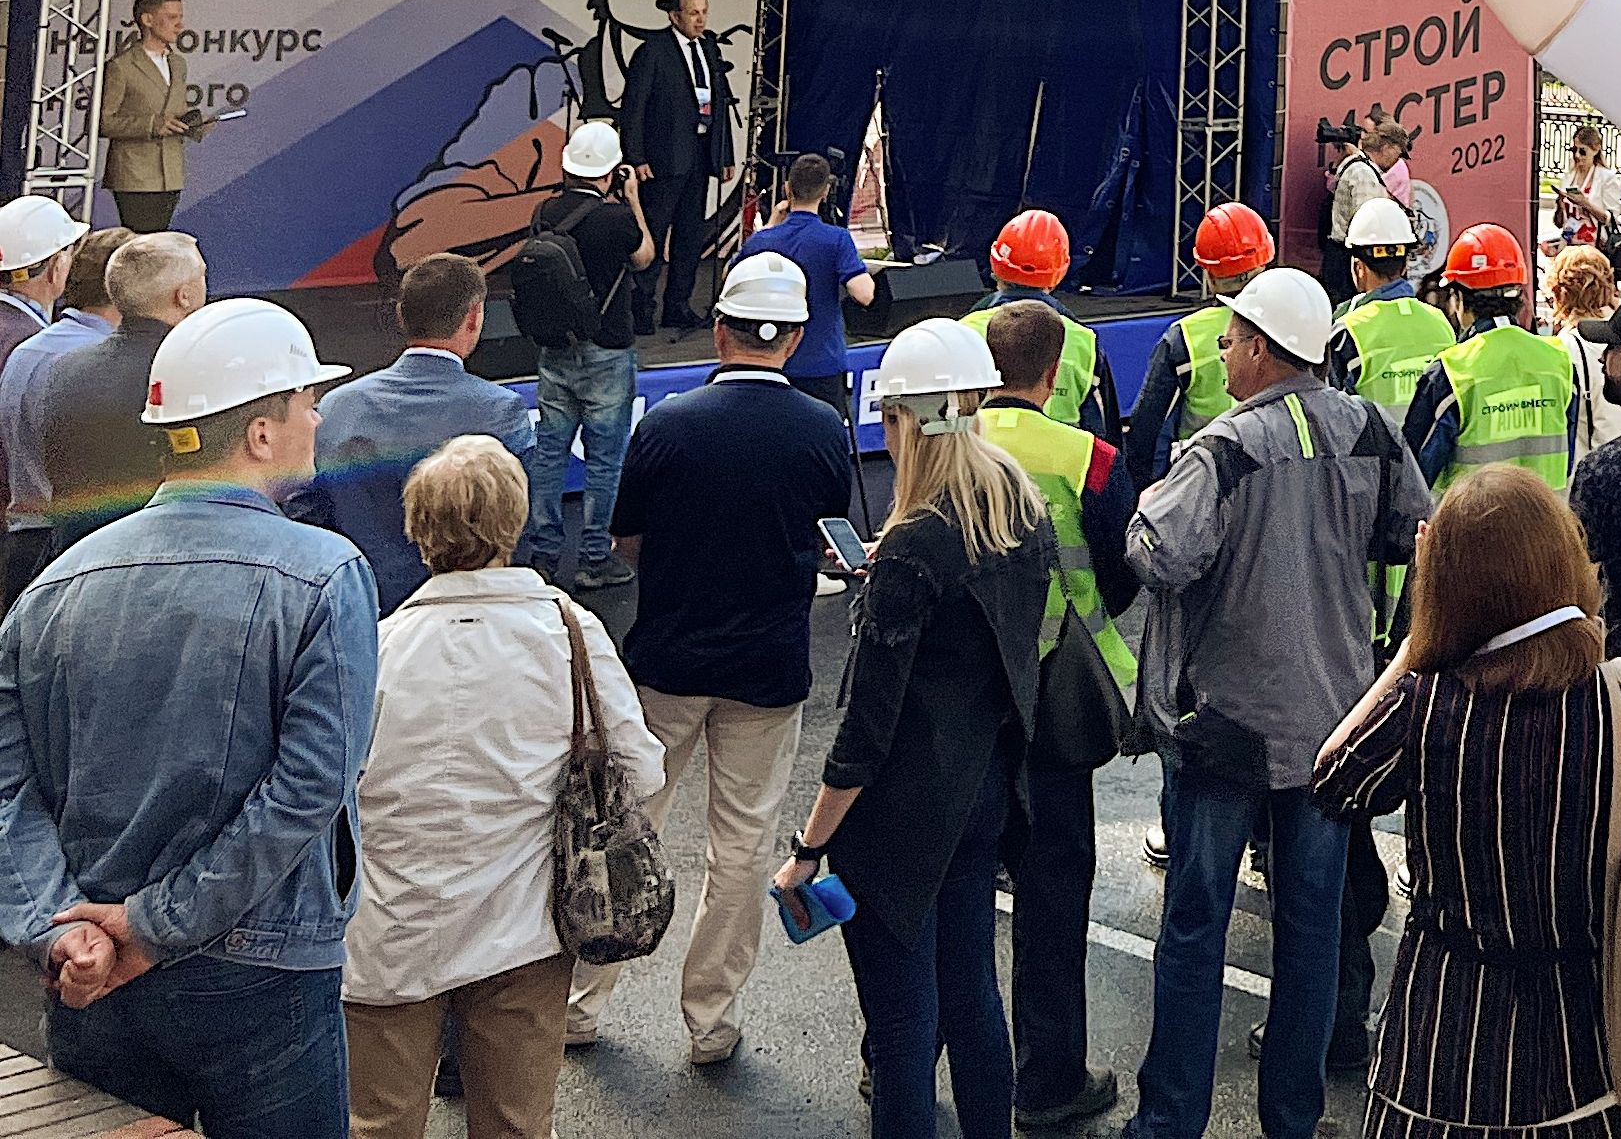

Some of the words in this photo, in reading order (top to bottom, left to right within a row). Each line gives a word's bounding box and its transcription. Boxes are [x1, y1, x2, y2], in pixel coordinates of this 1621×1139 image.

[172, 27, 322, 62] онкурс
[1317, 70, 1506, 168] СТЕР
[1451, 134, 1506, 175] 2022
[1481, 403, 1519, 416] СТРОИМ
